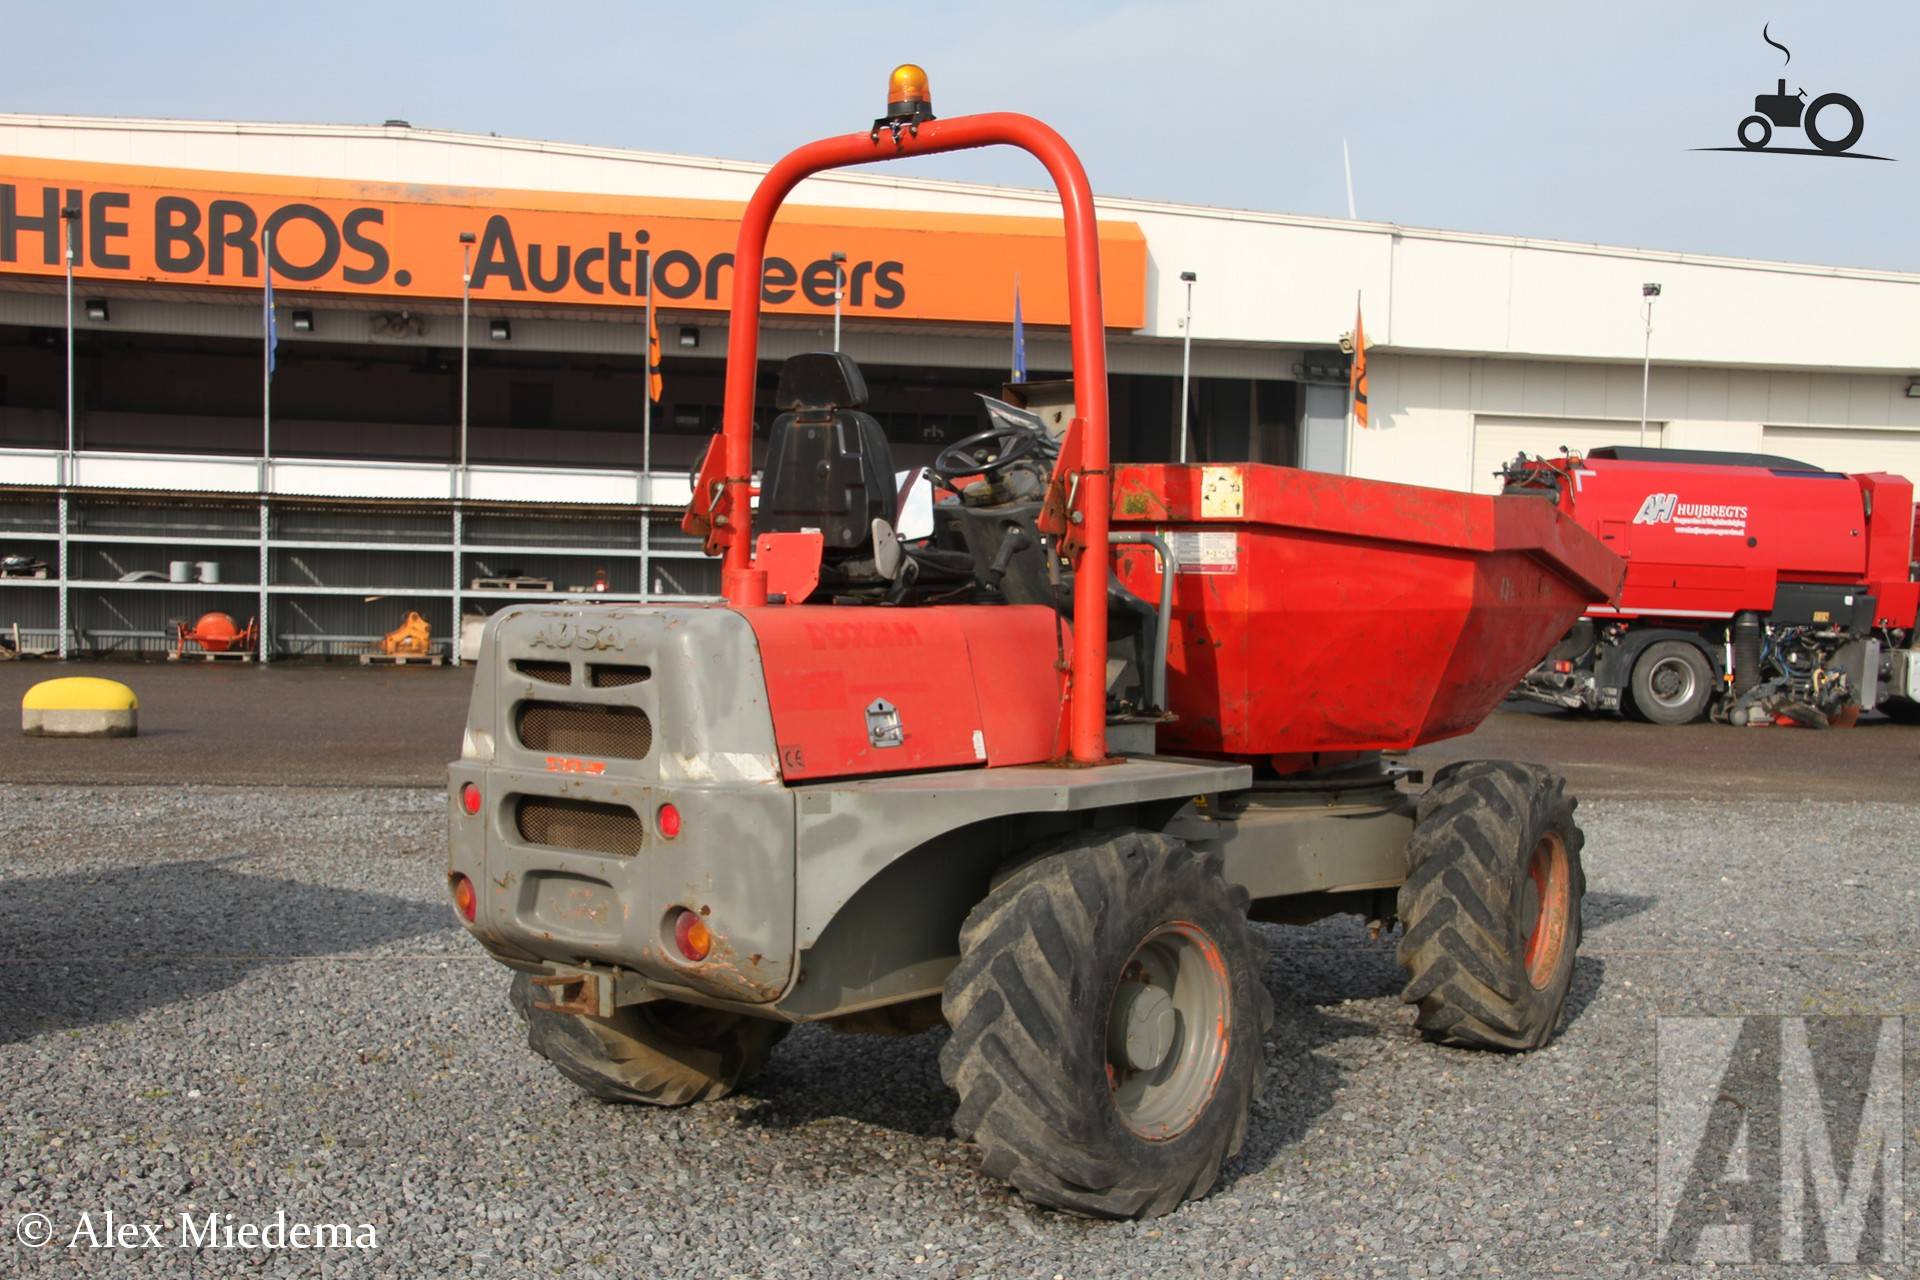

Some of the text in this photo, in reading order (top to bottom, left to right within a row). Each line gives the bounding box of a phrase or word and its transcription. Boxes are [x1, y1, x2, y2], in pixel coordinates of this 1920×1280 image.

[155, 196, 412, 287] BROS.
[470, 214, 905, 309] Auctioneers
[1677, 503, 1748, 519] HUIJBREGTS
[529, 622, 625, 651] AUSA
